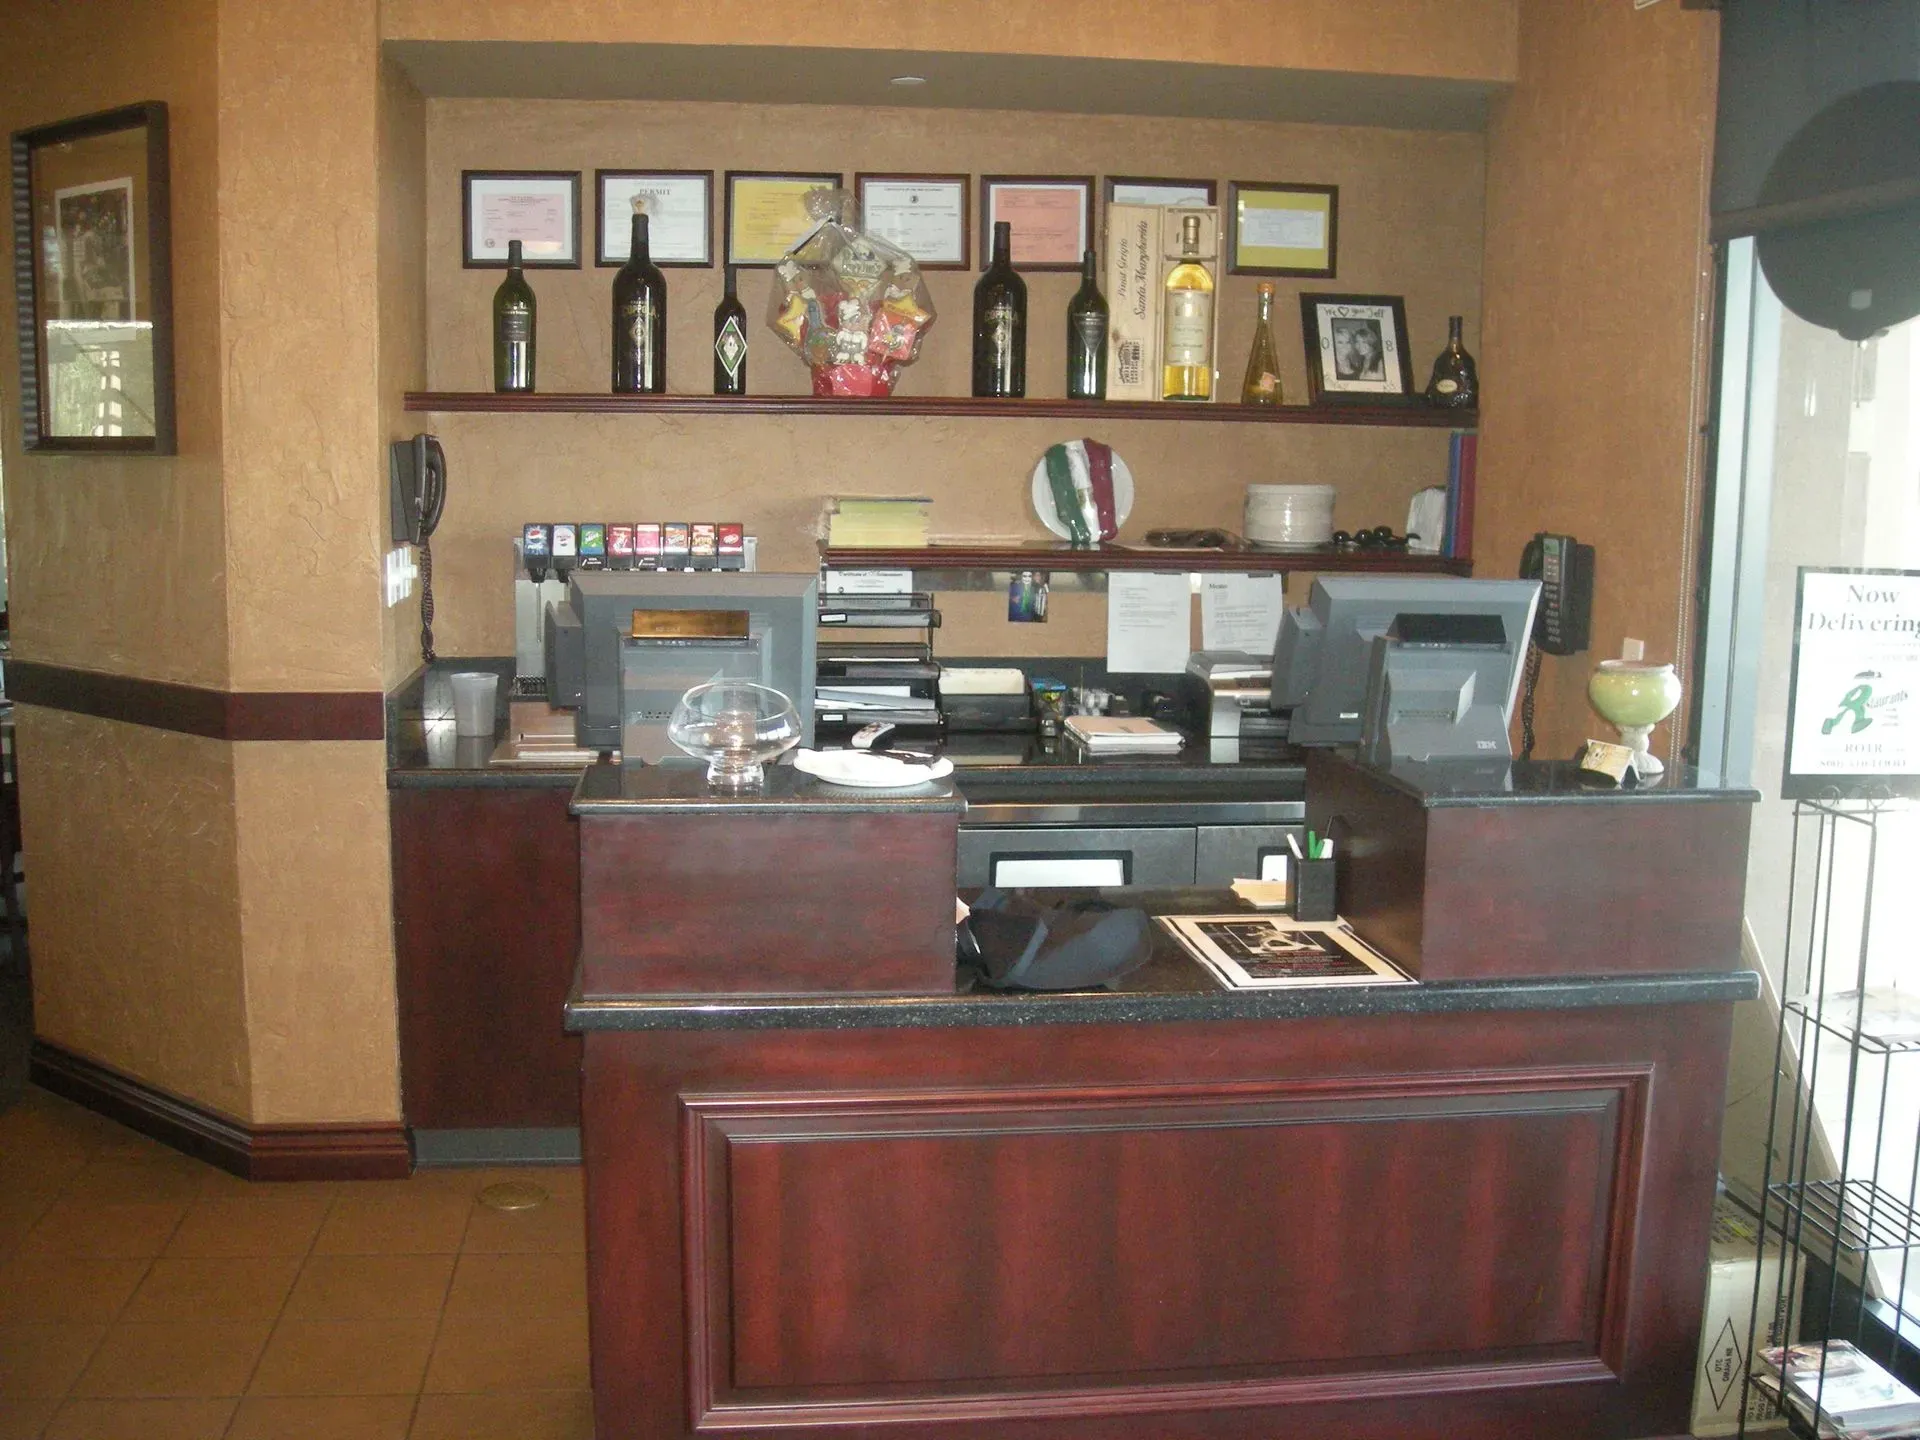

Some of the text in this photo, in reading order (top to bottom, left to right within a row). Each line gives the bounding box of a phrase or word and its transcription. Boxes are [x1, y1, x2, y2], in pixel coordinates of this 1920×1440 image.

[639, 188, 671, 196] PERMIT
[1133, 220, 1149, 320] Santa Margherita
[1118, 271, 1128, 298] Pinot
[1848, 584, 1900, 603] Now
[1476, 740, 1497, 749] IBM
[1721, 1357, 1733, 1382] OMAHA
